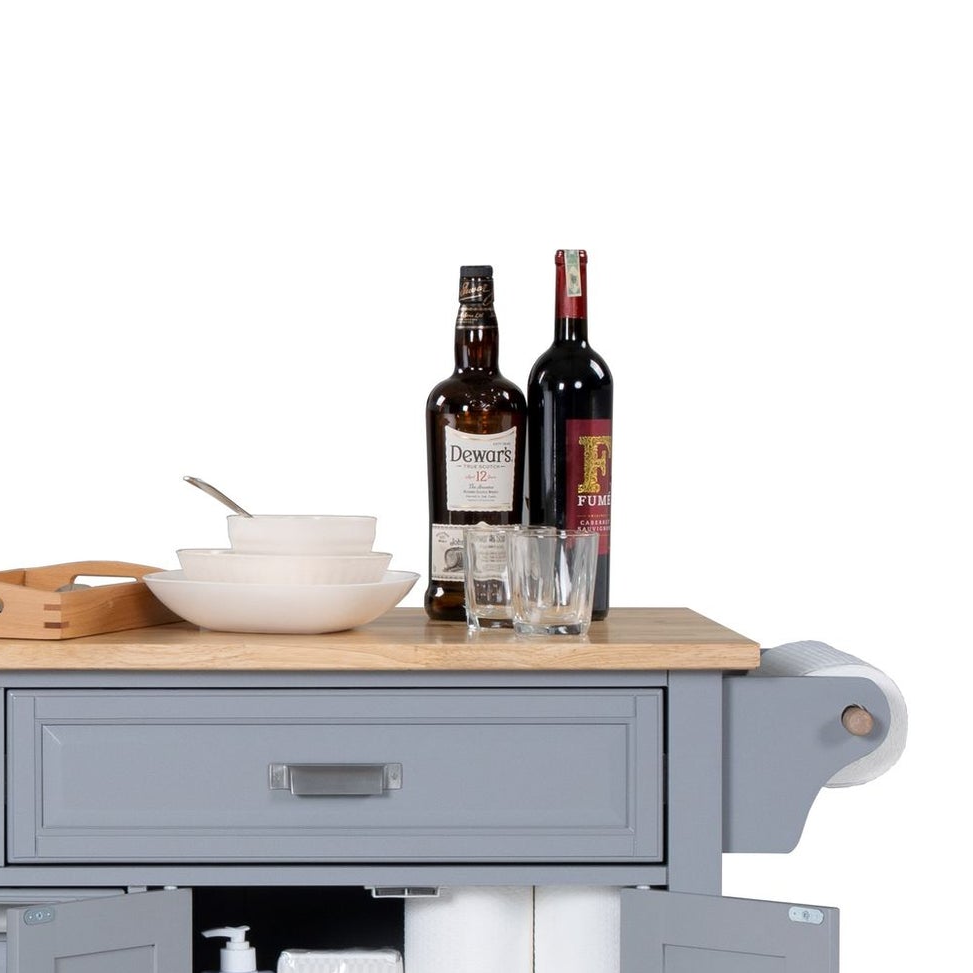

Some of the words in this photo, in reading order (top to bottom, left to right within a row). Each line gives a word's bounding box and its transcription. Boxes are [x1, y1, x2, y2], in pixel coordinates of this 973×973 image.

[450, 445, 512, 463] Dewar's
[578, 435, 612, 494] F
[476, 470, 487, 482] 12
